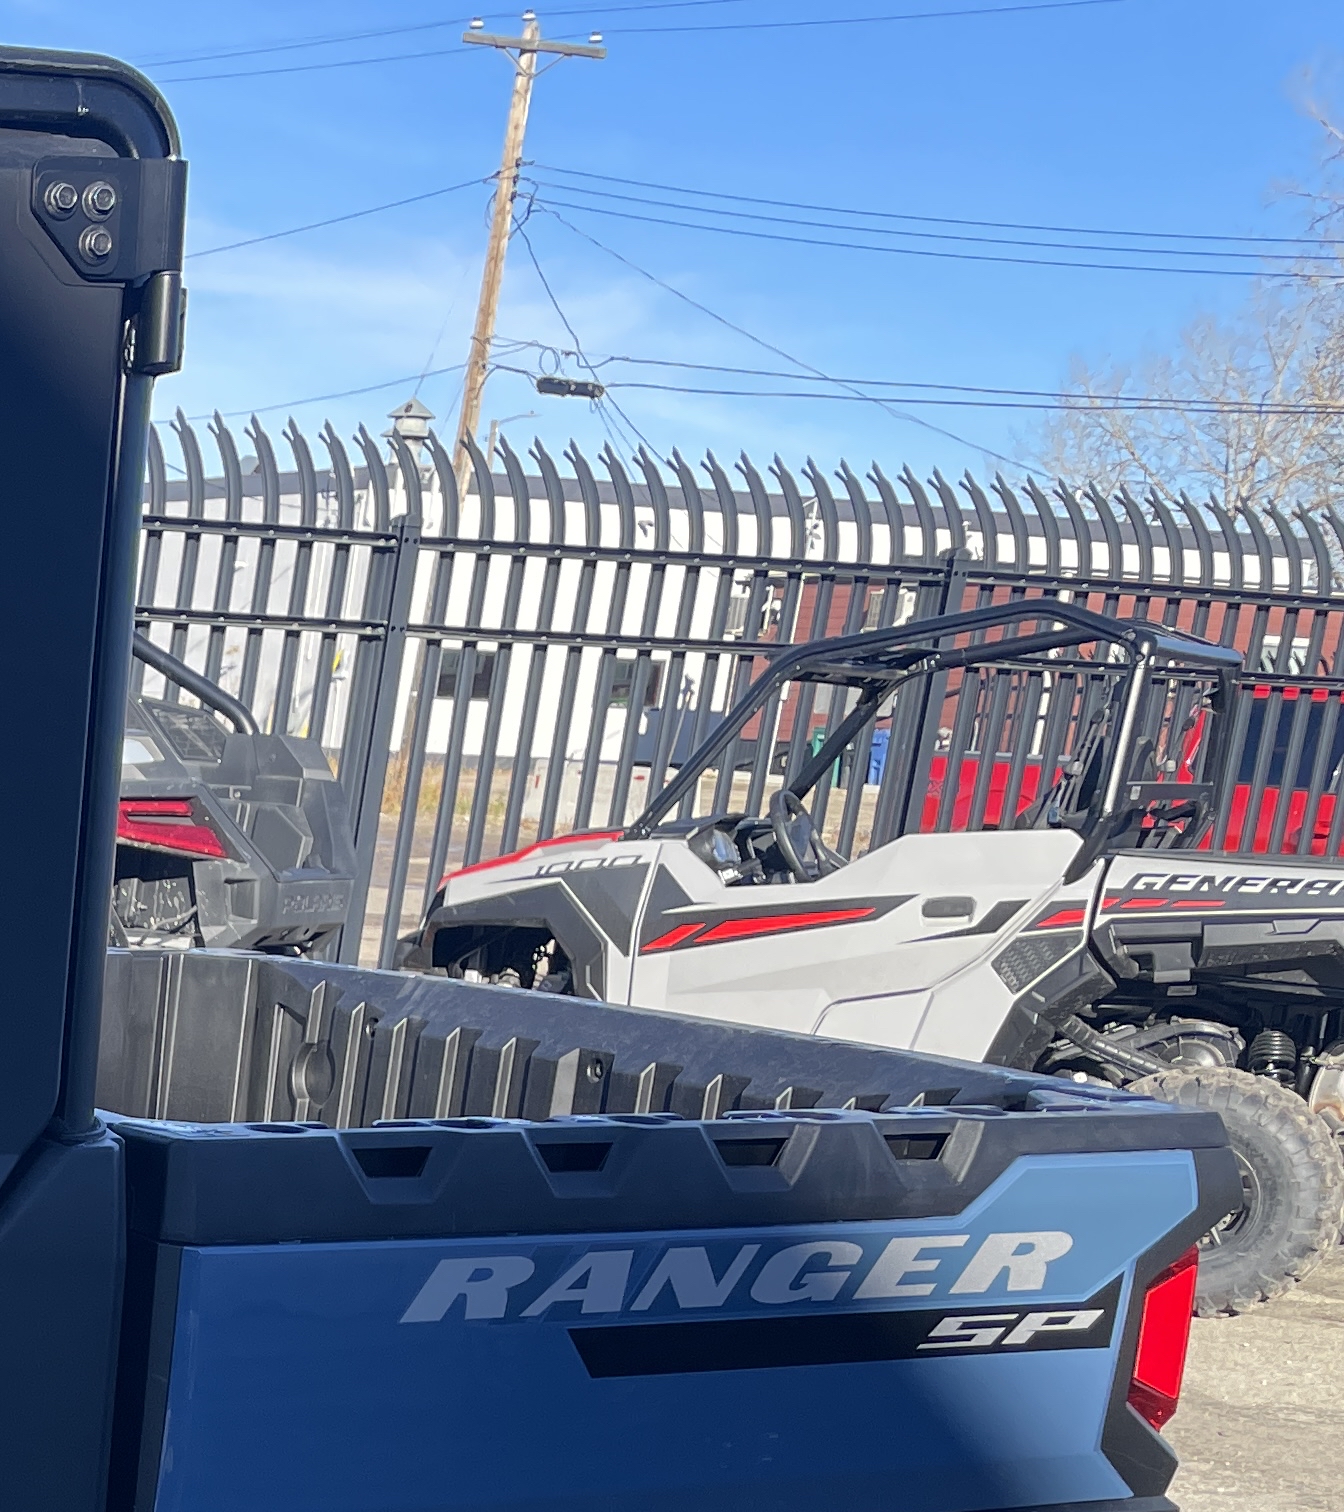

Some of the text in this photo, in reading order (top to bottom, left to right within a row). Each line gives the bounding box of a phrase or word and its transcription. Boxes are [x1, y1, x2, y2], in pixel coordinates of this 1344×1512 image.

[534, 855, 642, 878] 1000
[1130, 872, 1344, 896] GENERA
[398, 1230, 1074, 1324] RANGER
[917, 1309, 1105, 1350] SP
